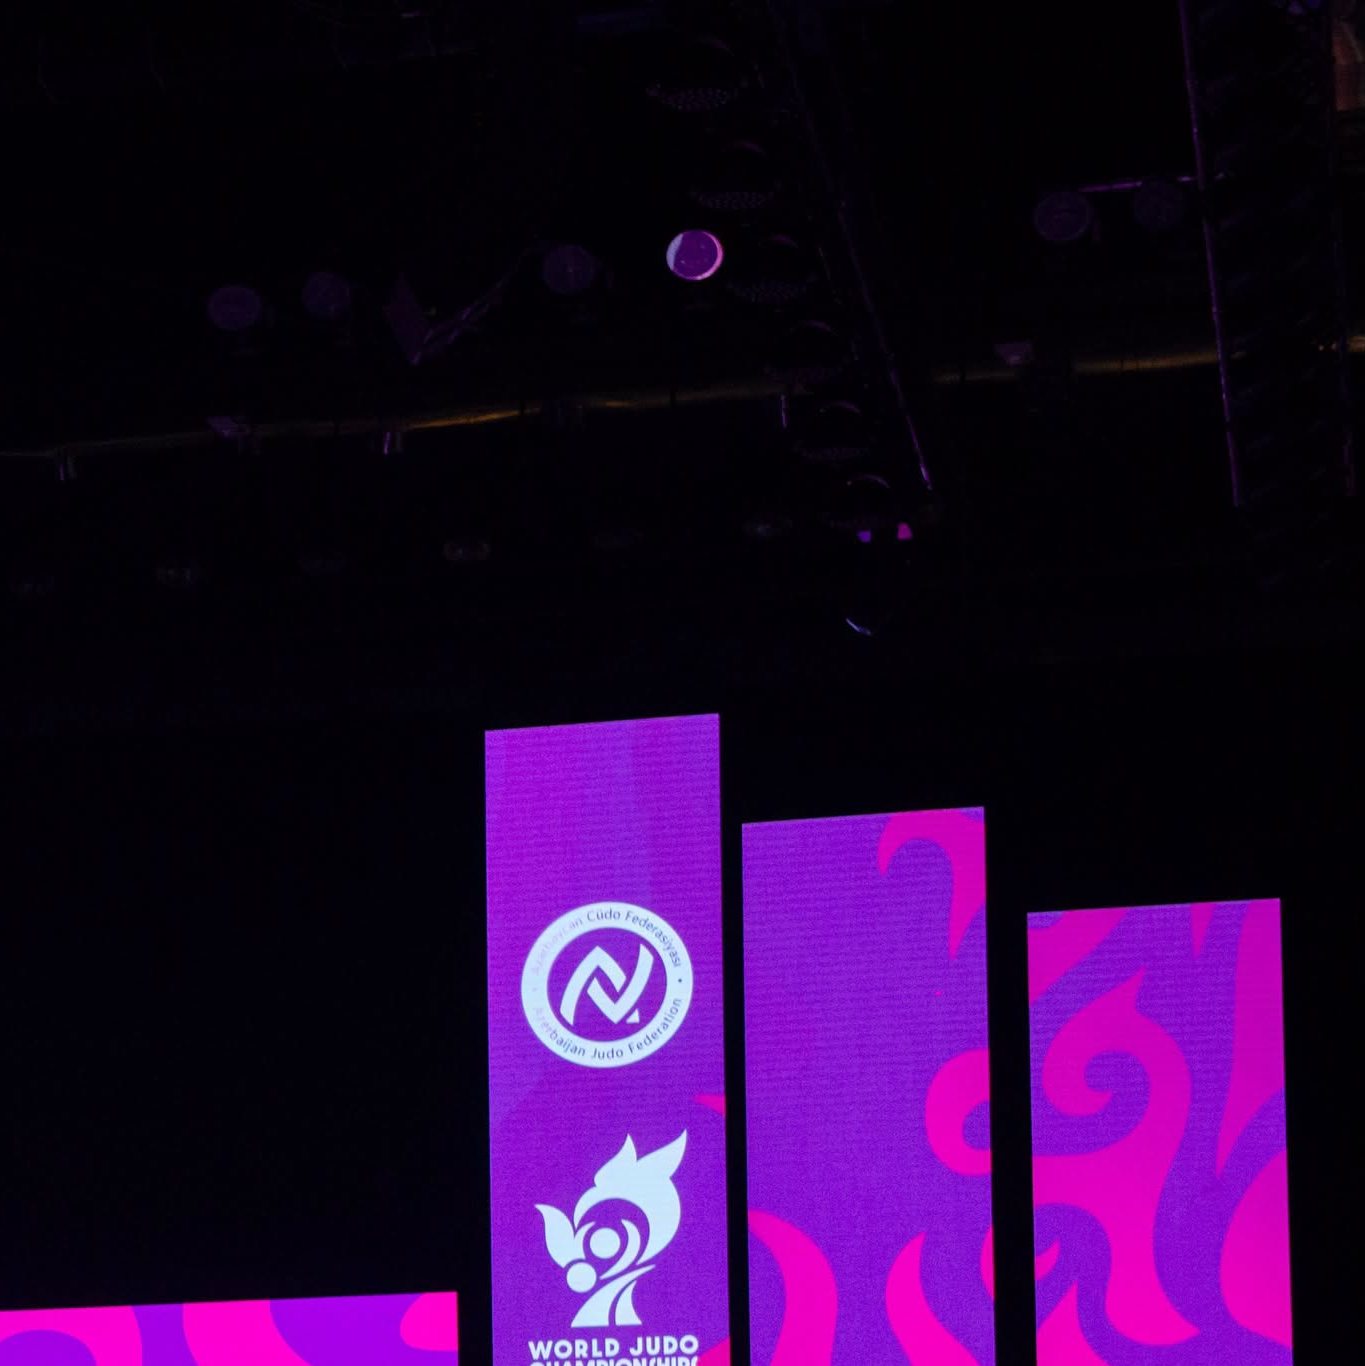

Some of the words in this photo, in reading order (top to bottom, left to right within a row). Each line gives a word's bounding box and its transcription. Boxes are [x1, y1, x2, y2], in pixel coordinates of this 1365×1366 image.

[591, 1047, 624, 1061] Judo
[627, 997, 683, 1054] Federation
[528, 1338, 620, 1360] WORLD
[630, 1334, 699, 1356] JUDO
